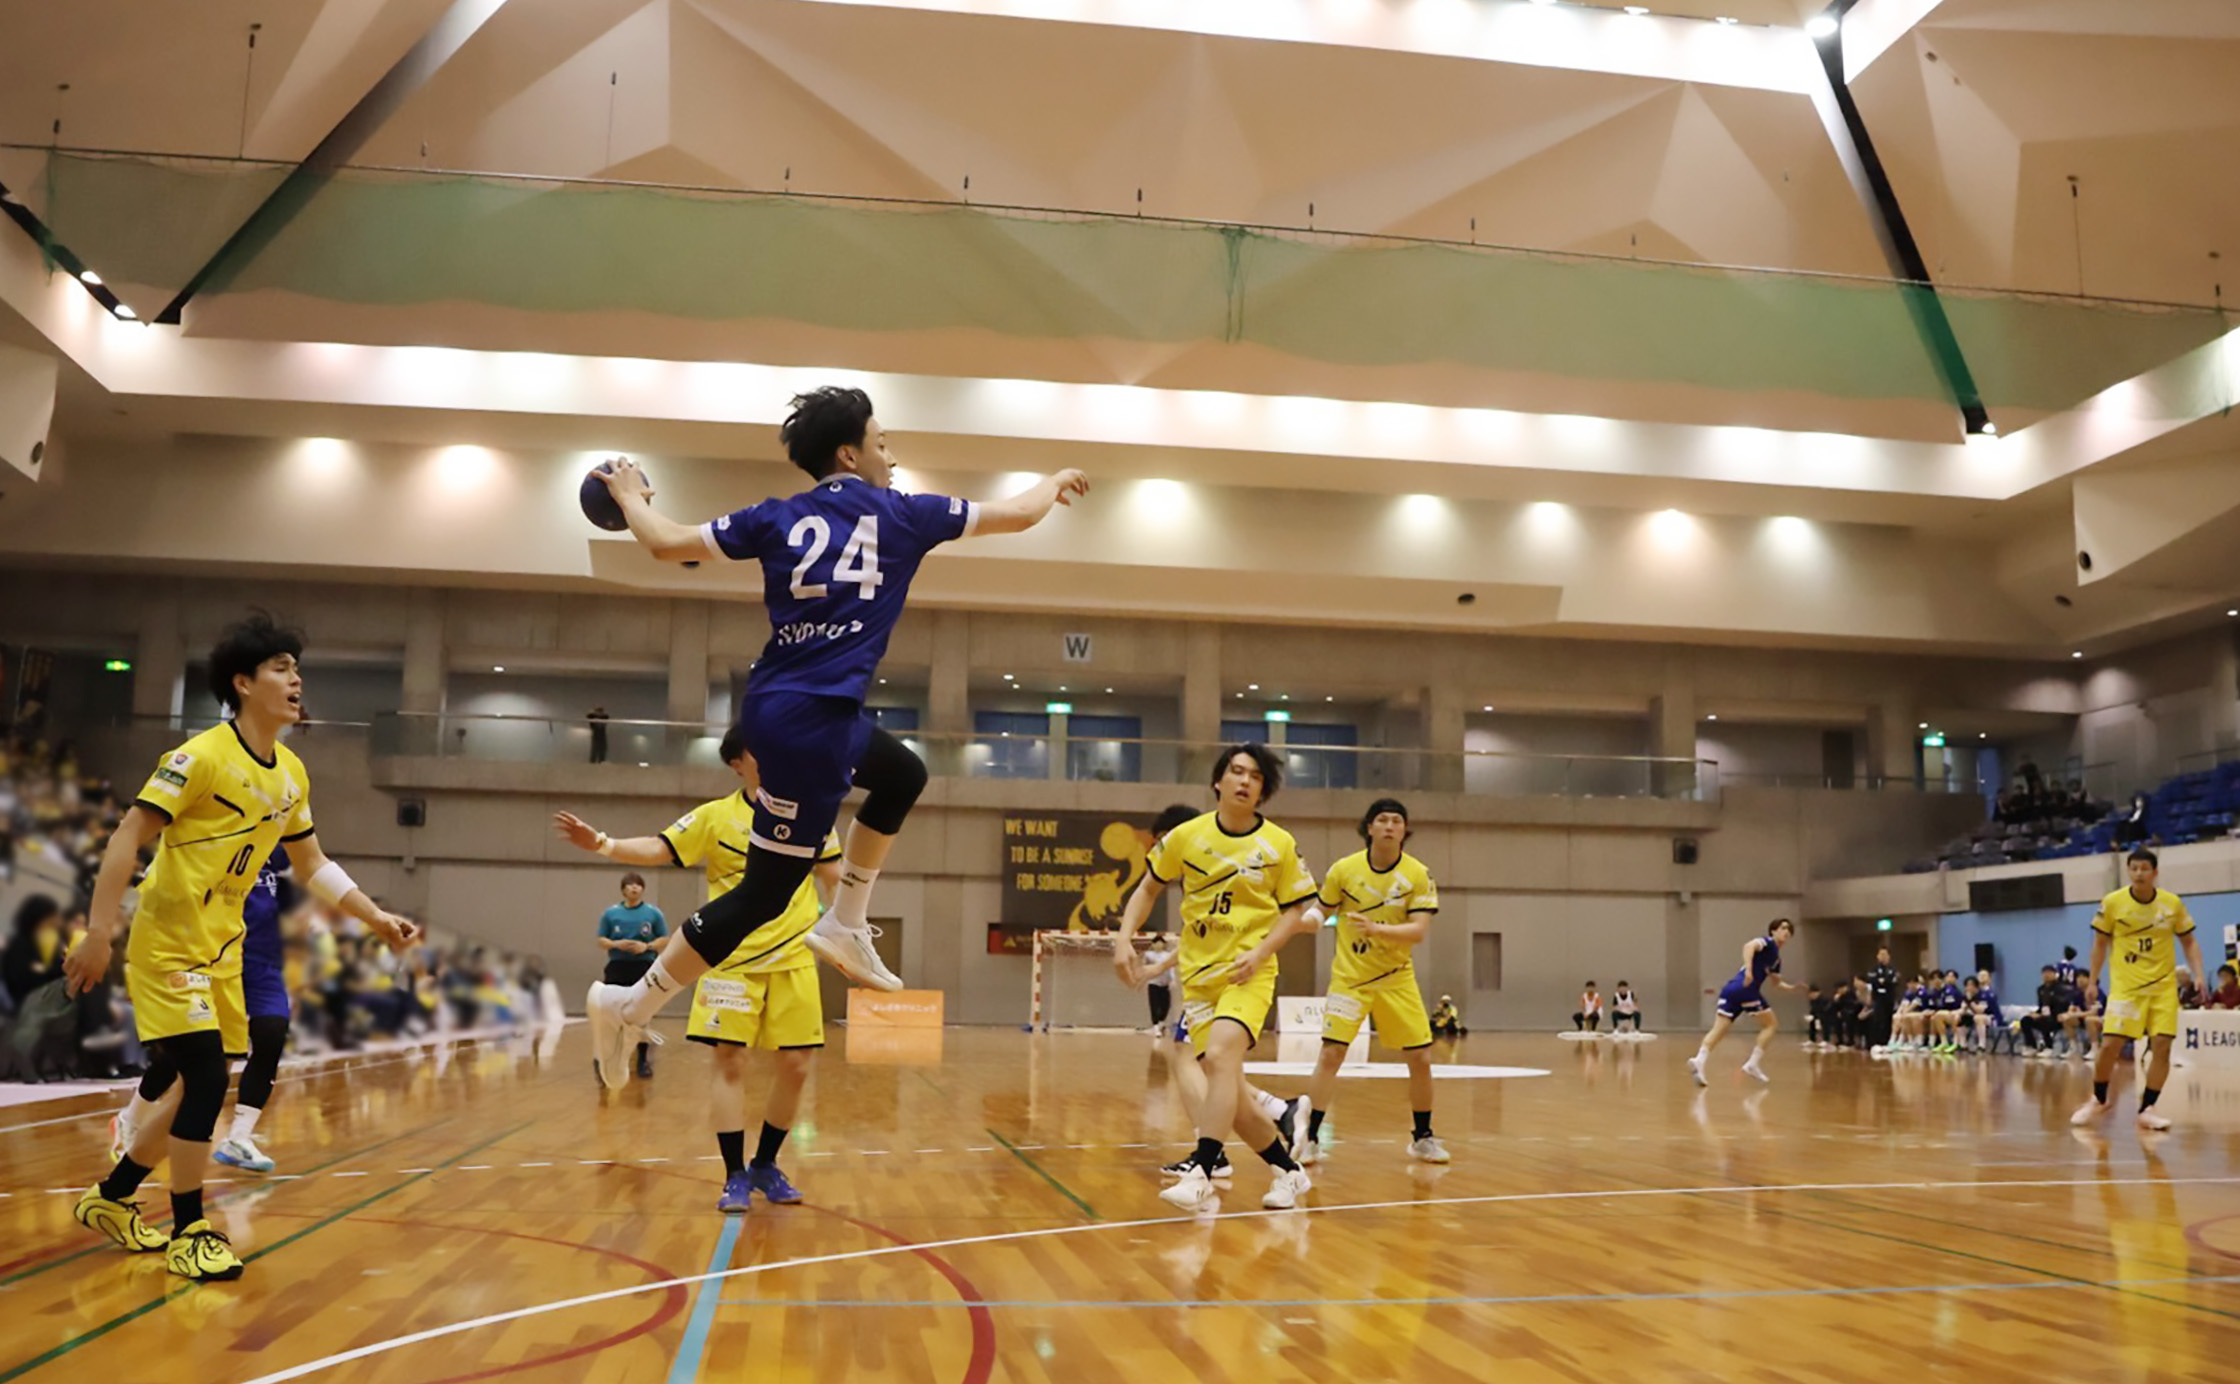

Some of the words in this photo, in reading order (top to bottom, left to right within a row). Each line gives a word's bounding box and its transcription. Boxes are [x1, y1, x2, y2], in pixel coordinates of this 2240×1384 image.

[786, 515, 884, 600] 24
[1065, 636, 1090, 659] W
[1005, 819, 1022, 835] WE
[1024, 820, 1058, 837] WANT
[226, 843, 255, 876] 10
[1011, 846, 1024, 863] TO
[1026, 847, 1039, 864] BE
[1042, 848, 1051, 864] A
[1053, 848, 1094, 865] SUNRISE
[1016, 873, 1035, 891] FOR
